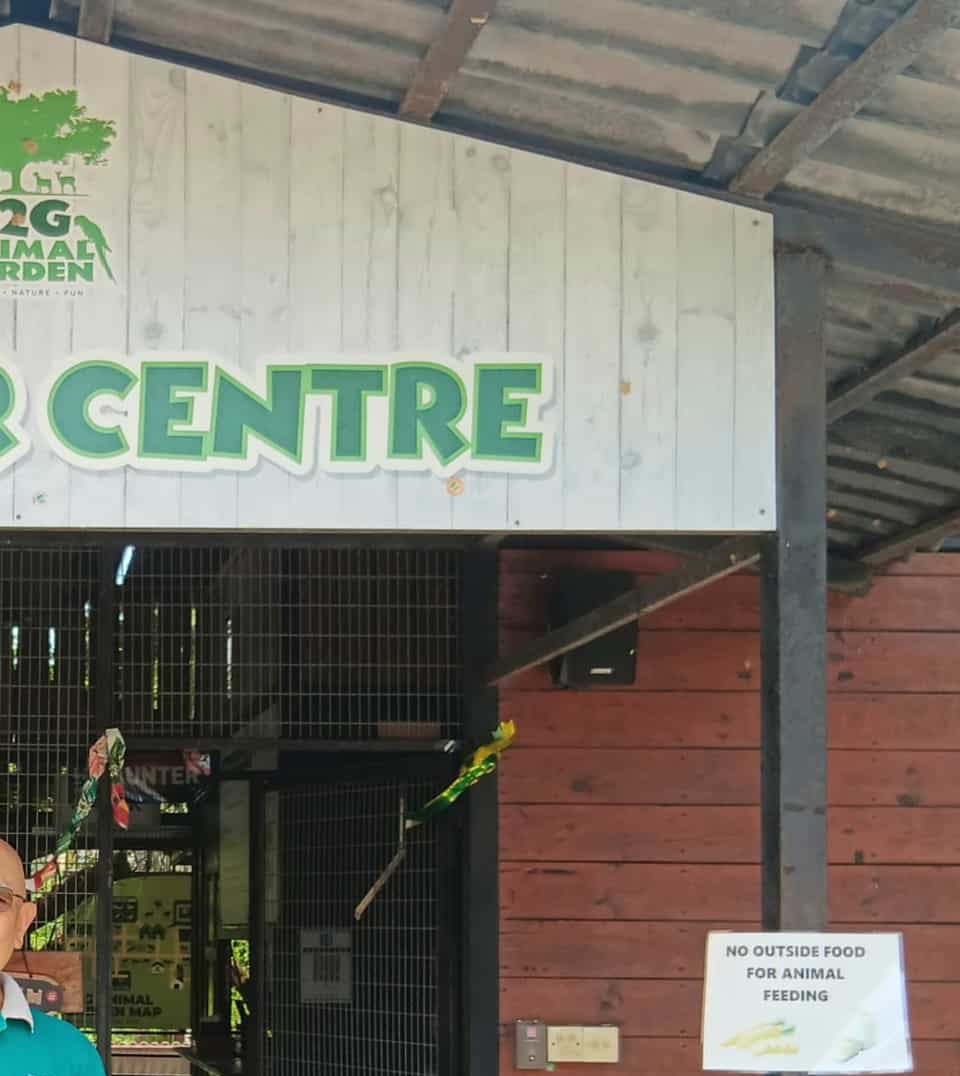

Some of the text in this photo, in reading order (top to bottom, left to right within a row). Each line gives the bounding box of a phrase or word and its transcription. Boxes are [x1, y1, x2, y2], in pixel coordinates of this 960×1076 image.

[11, 287, 50, 297] NATURE
[63, 288, 84, 297] FUN
[47, 358, 542, 467] CENTRE
[726, 945, 866, 958] NO OUTSIDE FOOD
[746, 967, 846, 980] FOR ANIMAL
[763, 989, 829, 1002] FEEDING
